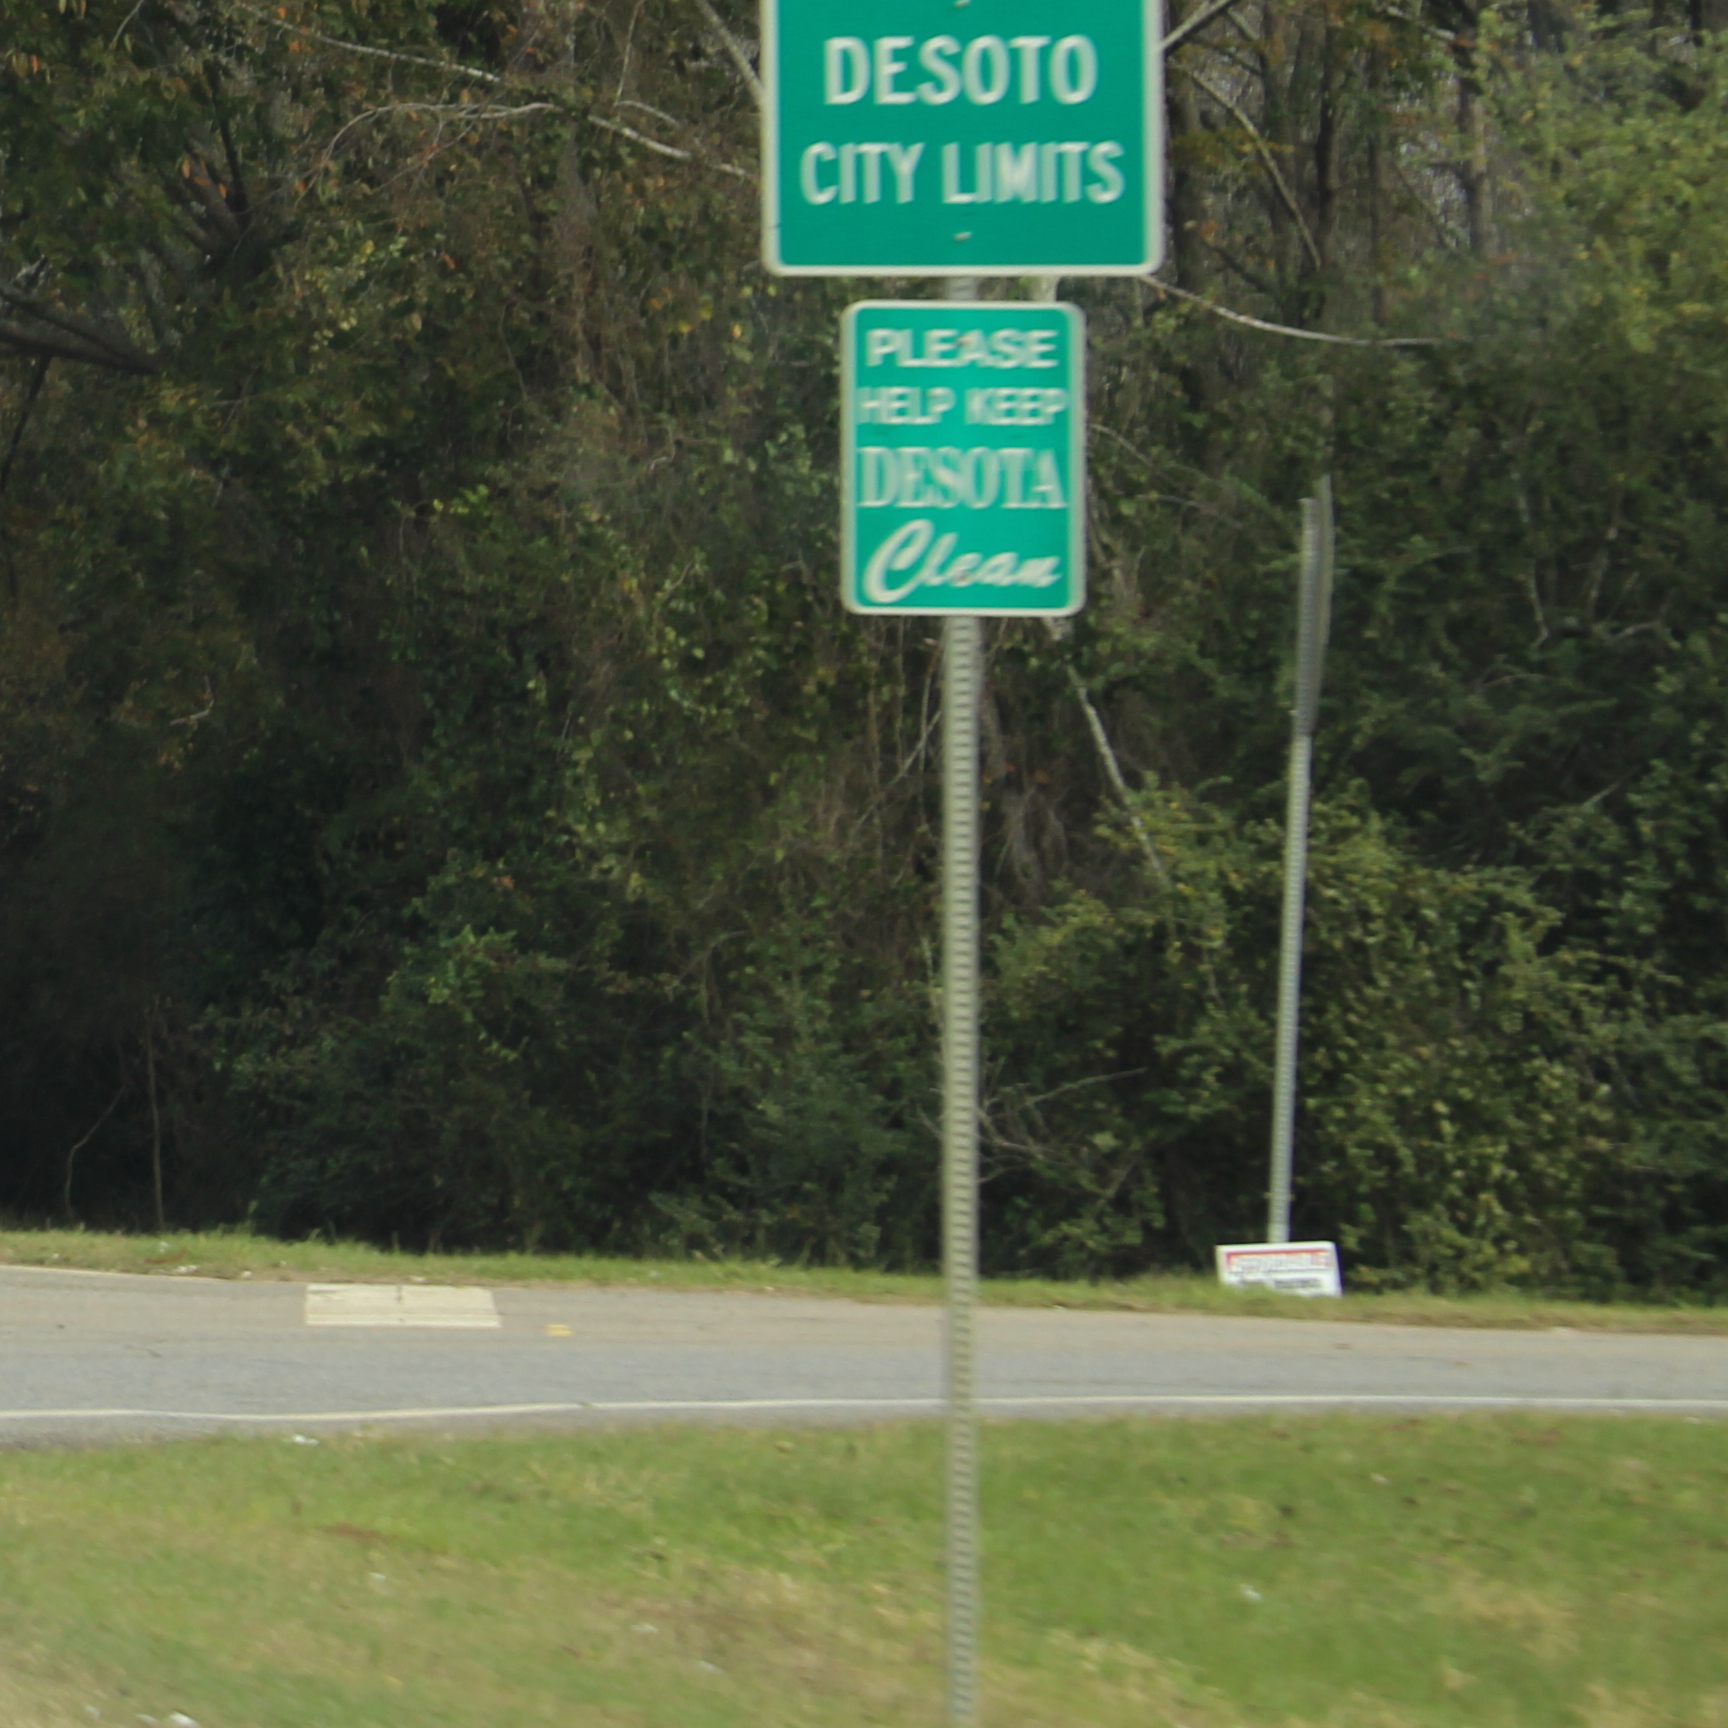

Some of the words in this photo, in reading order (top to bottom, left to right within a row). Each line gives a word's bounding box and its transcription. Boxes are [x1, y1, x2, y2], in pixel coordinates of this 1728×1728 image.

[824, 34, 1098, 105] DESOTO
[799, 140, 925, 205] CITY
[942, 140, 1126, 204] LIMITS
[865, 328, 1060, 368] PLEASE
[858, 386, 956, 424] HELP
[965, 387, 1069, 425] KEEP
[862, 518, 1062, 604] Clean
